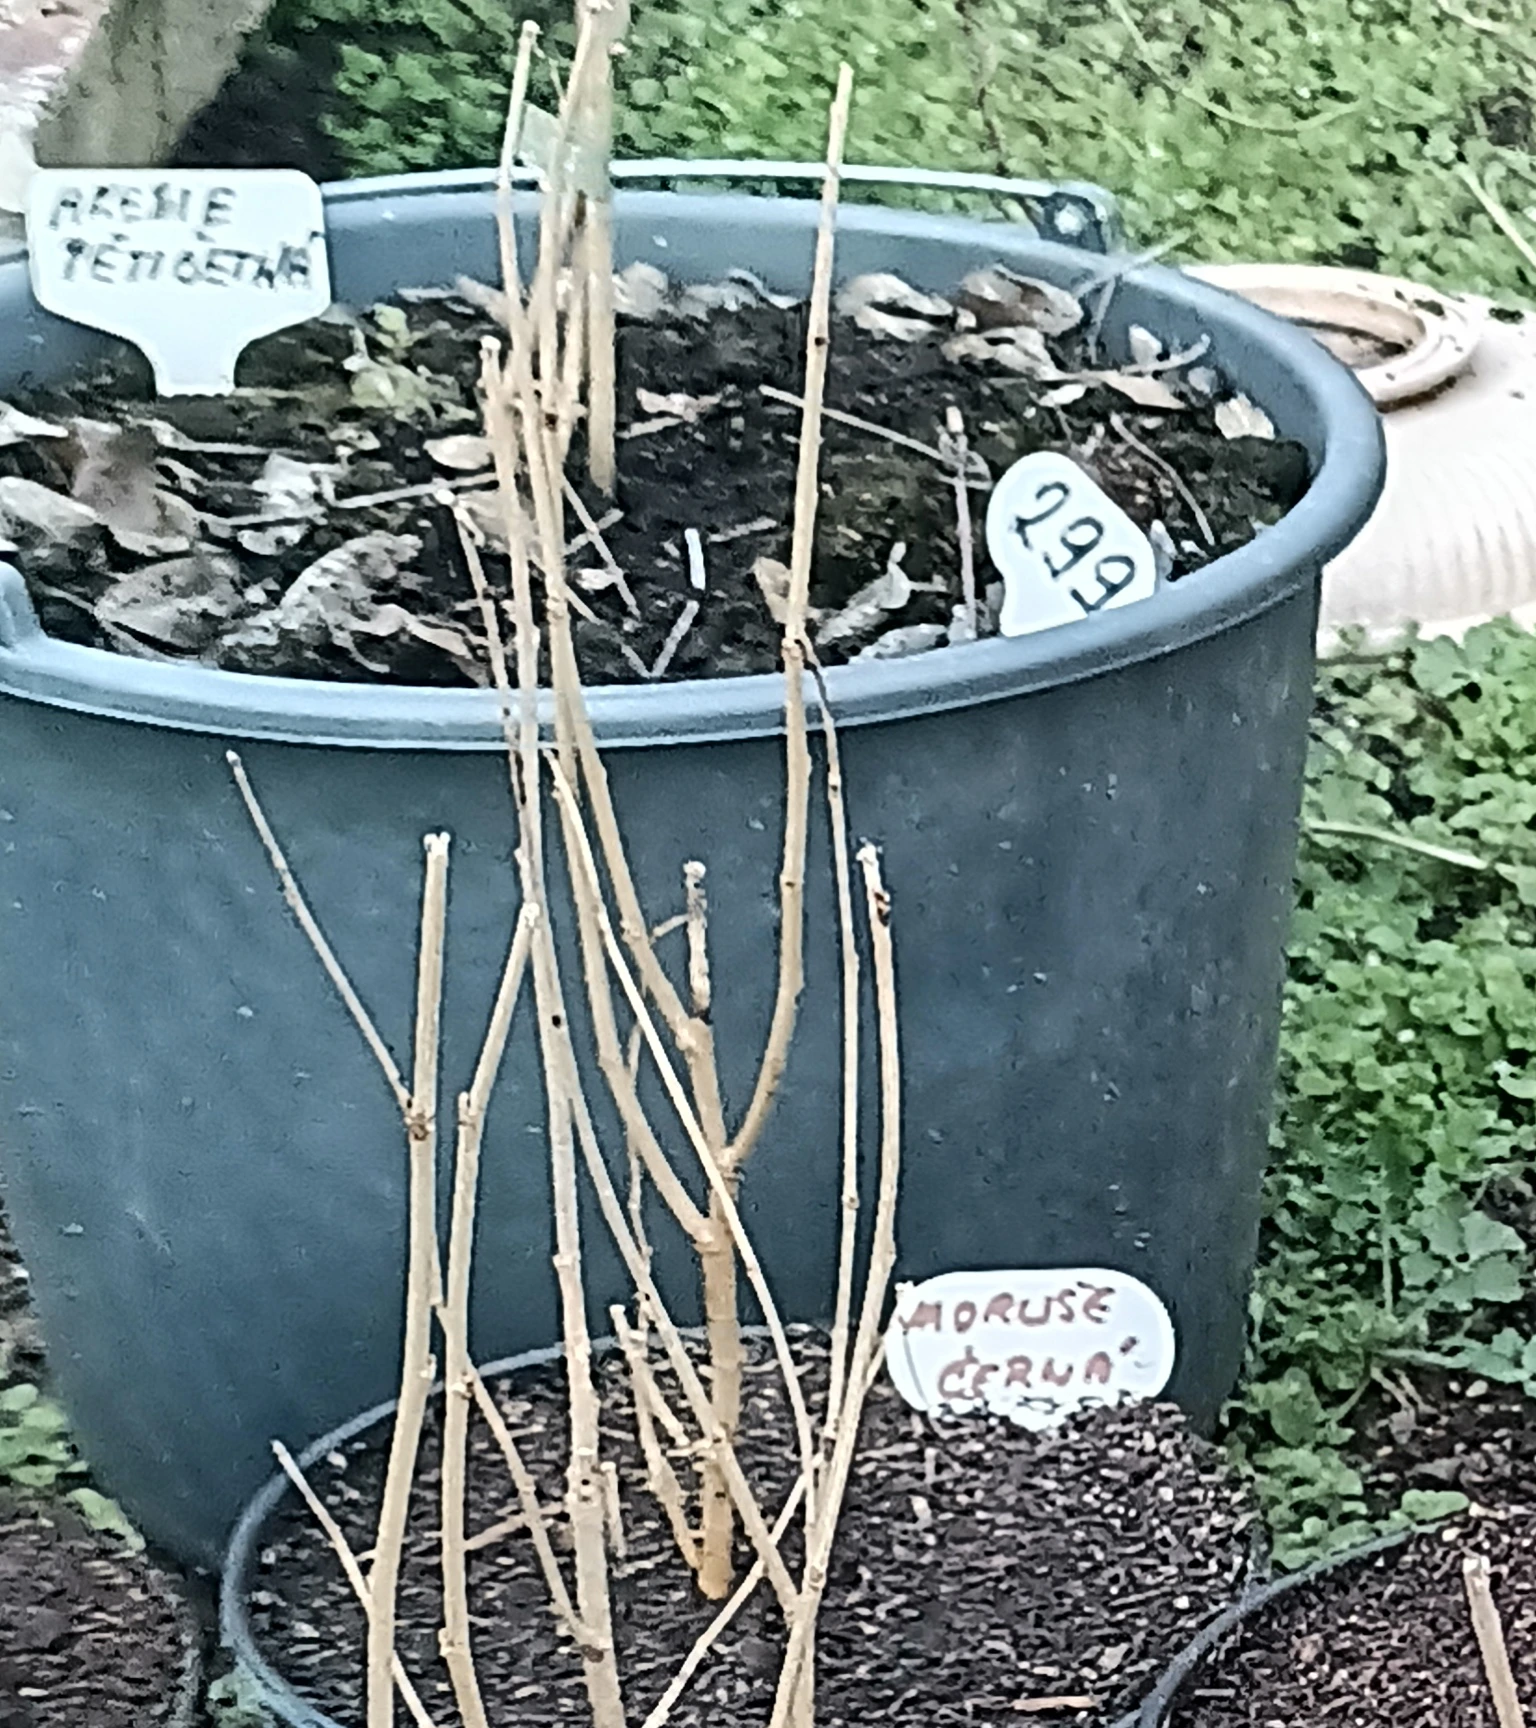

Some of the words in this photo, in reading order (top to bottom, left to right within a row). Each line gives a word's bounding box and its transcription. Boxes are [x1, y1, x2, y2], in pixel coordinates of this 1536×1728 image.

[1010, 482, 1136, 614] 299
[899, 1281, 1115, 1335] MORUŠE
[937, 1337, 1138, 1400] ČERNÁ
